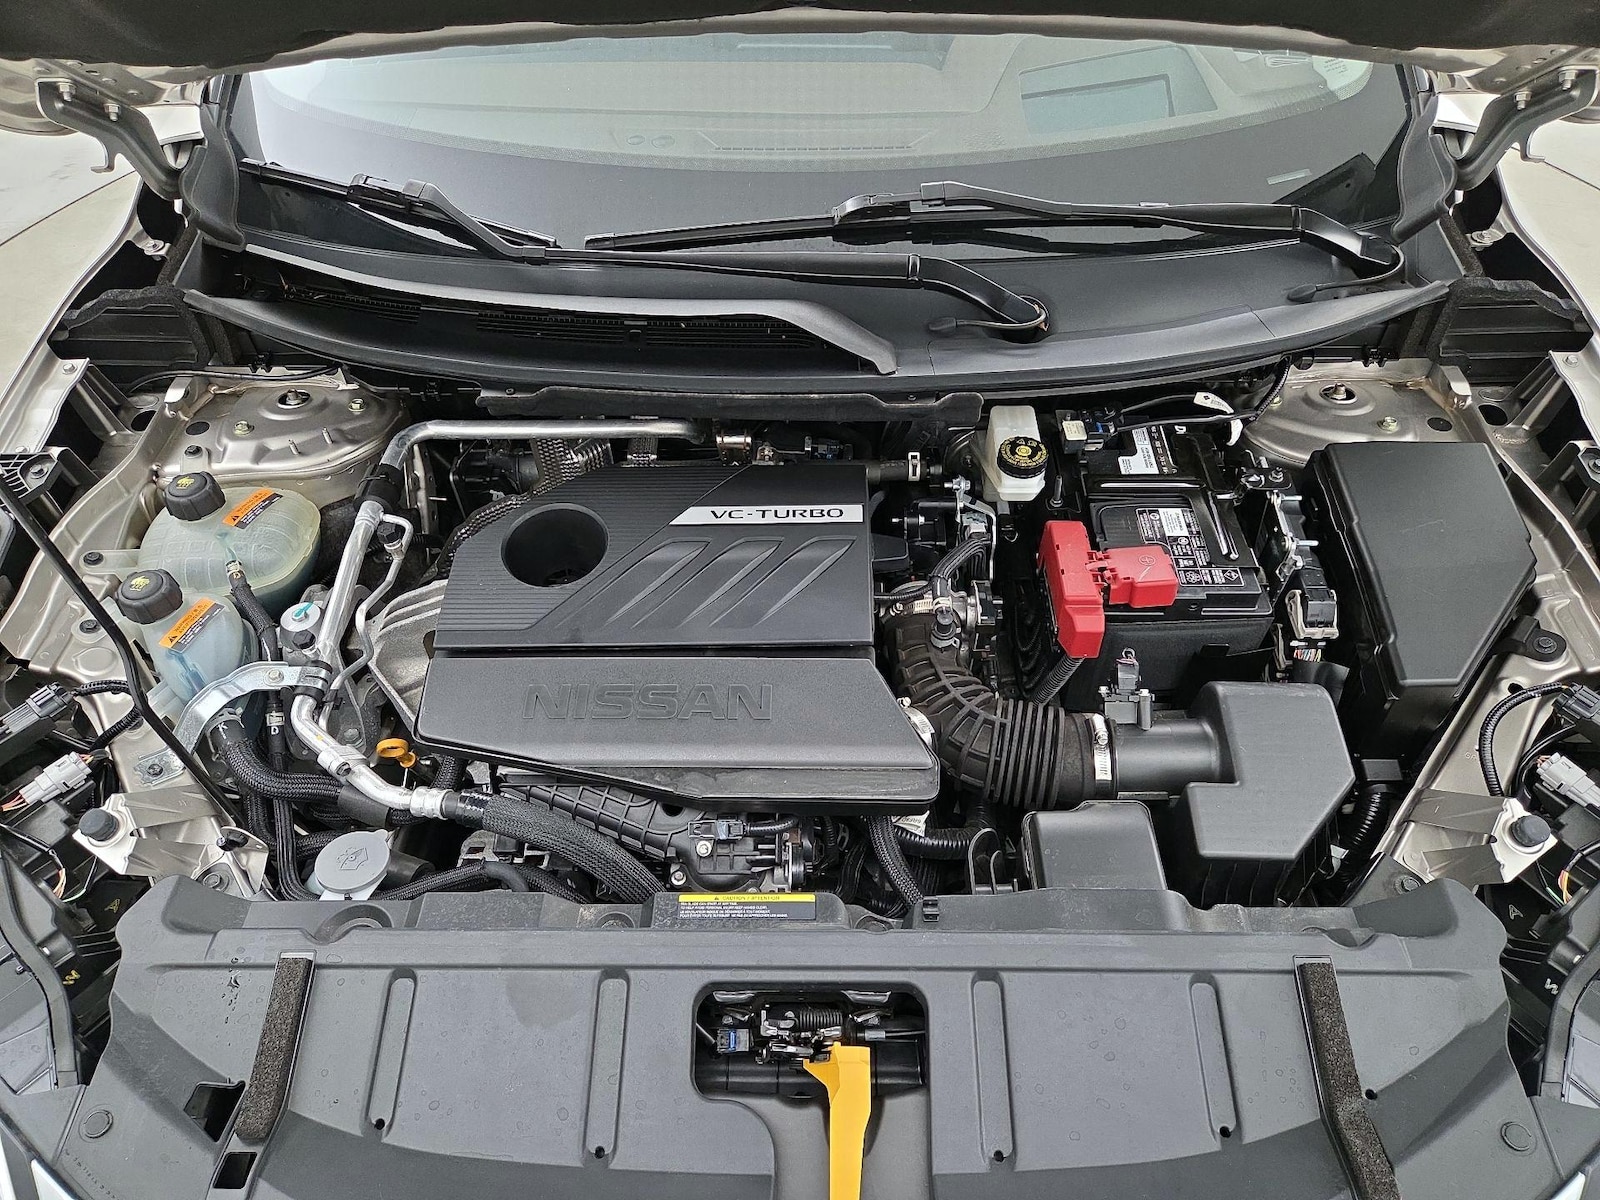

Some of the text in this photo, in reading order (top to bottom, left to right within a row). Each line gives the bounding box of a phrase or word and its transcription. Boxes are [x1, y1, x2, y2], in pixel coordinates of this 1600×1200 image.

[522, 683, 773, 721] NISSAN
[270, 726, 279, 735] D
[1508, 904, 1523, 920] A
